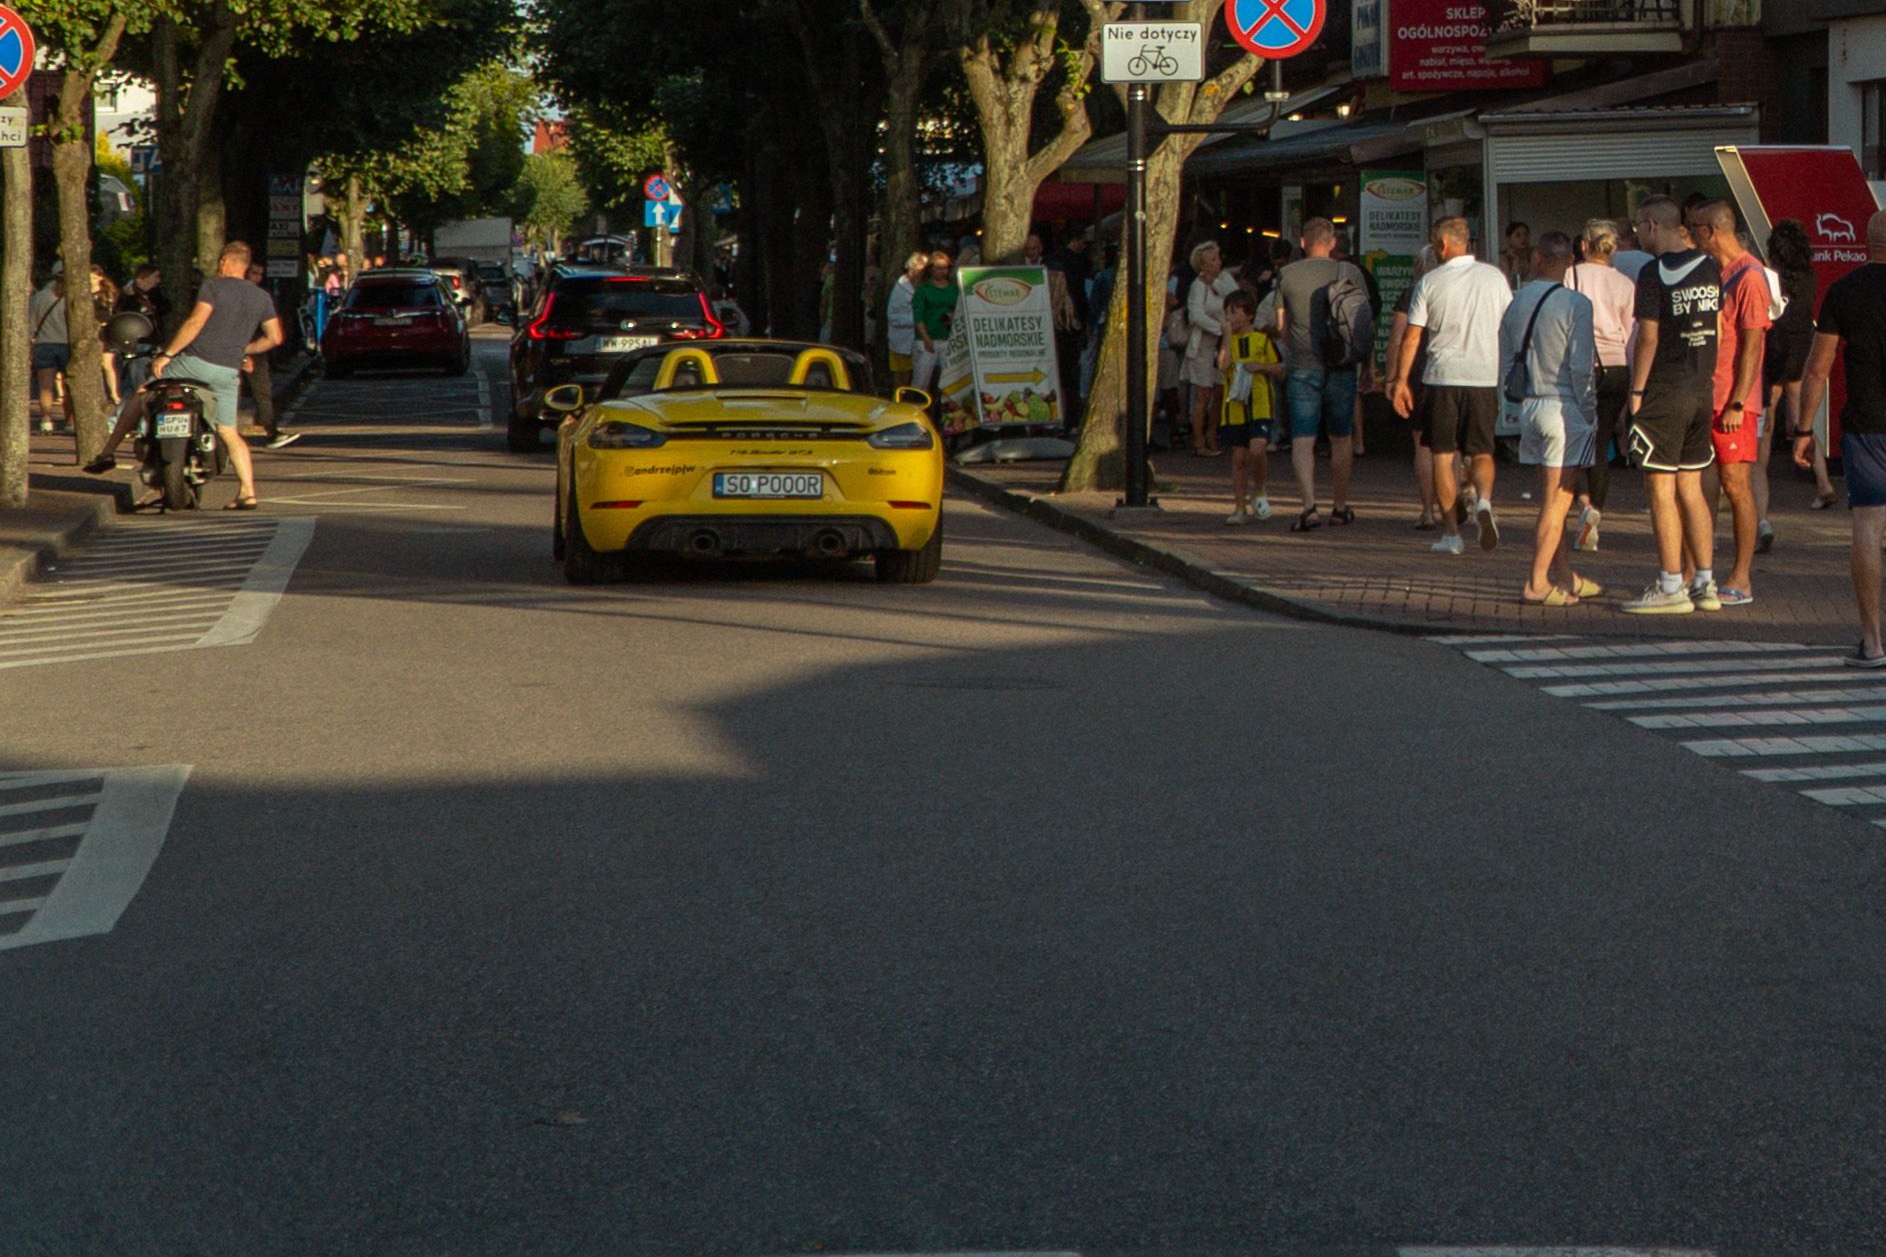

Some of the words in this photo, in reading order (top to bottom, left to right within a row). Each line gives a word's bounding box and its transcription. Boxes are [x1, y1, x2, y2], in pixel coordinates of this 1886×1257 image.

[1445, 6, 1486, 21] SKLEP
[1107, 27, 1134, 40] Nie
[1139, 26, 1198, 43] dotyczy
[1369, 210, 1421, 221] DELIKATESY
[1833, 249, 1867, 262] Pekao
[1672, 285, 1720, 304] SWOOSH
[1672, 302, 1692, 316] BY
[973, 315, 1043, 333] DELIKATESY
[976, 331, 1045, 348] NADMORSKIE
